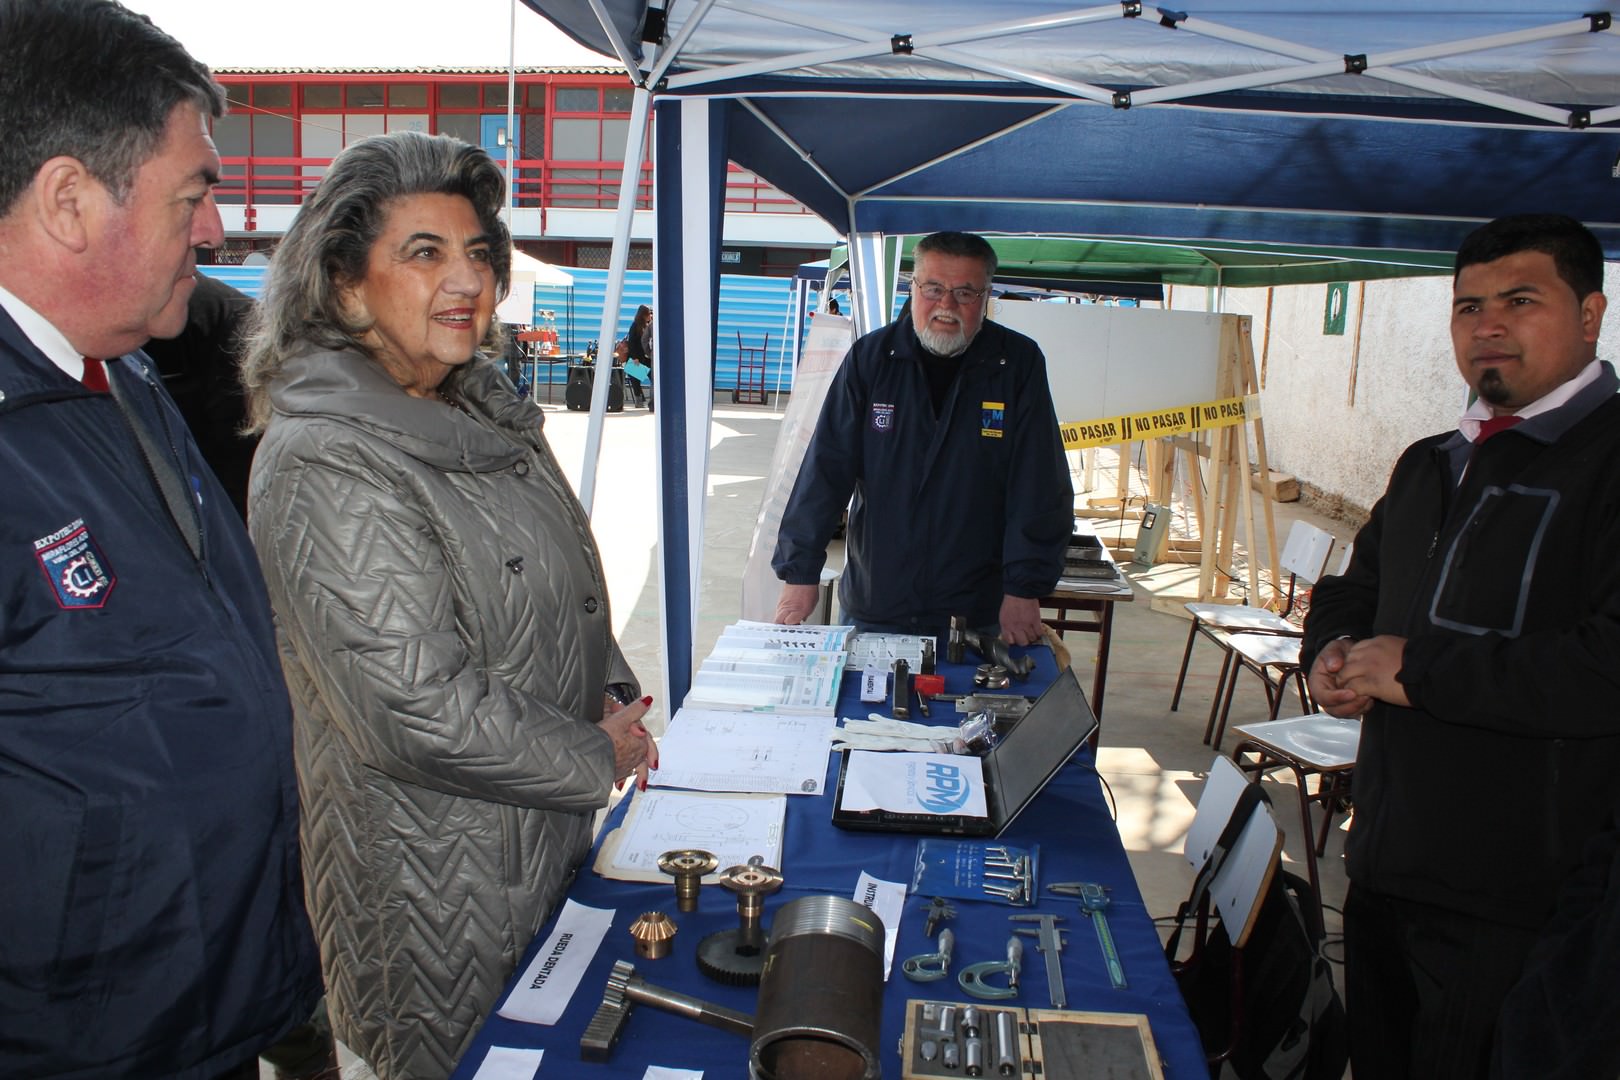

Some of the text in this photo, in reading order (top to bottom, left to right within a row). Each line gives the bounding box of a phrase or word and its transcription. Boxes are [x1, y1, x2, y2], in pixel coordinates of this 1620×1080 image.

[1135, 411, 1187, 432] NO PASAR
[1203, 401, 1246, 421] NO PASA
[1062, 423, 1117, 443] NO PASAR
[926, 762, 961, 808] RPM
[551, 933, 574, 956] RUEDA
[529, 956, 560, 990] DENTADA
